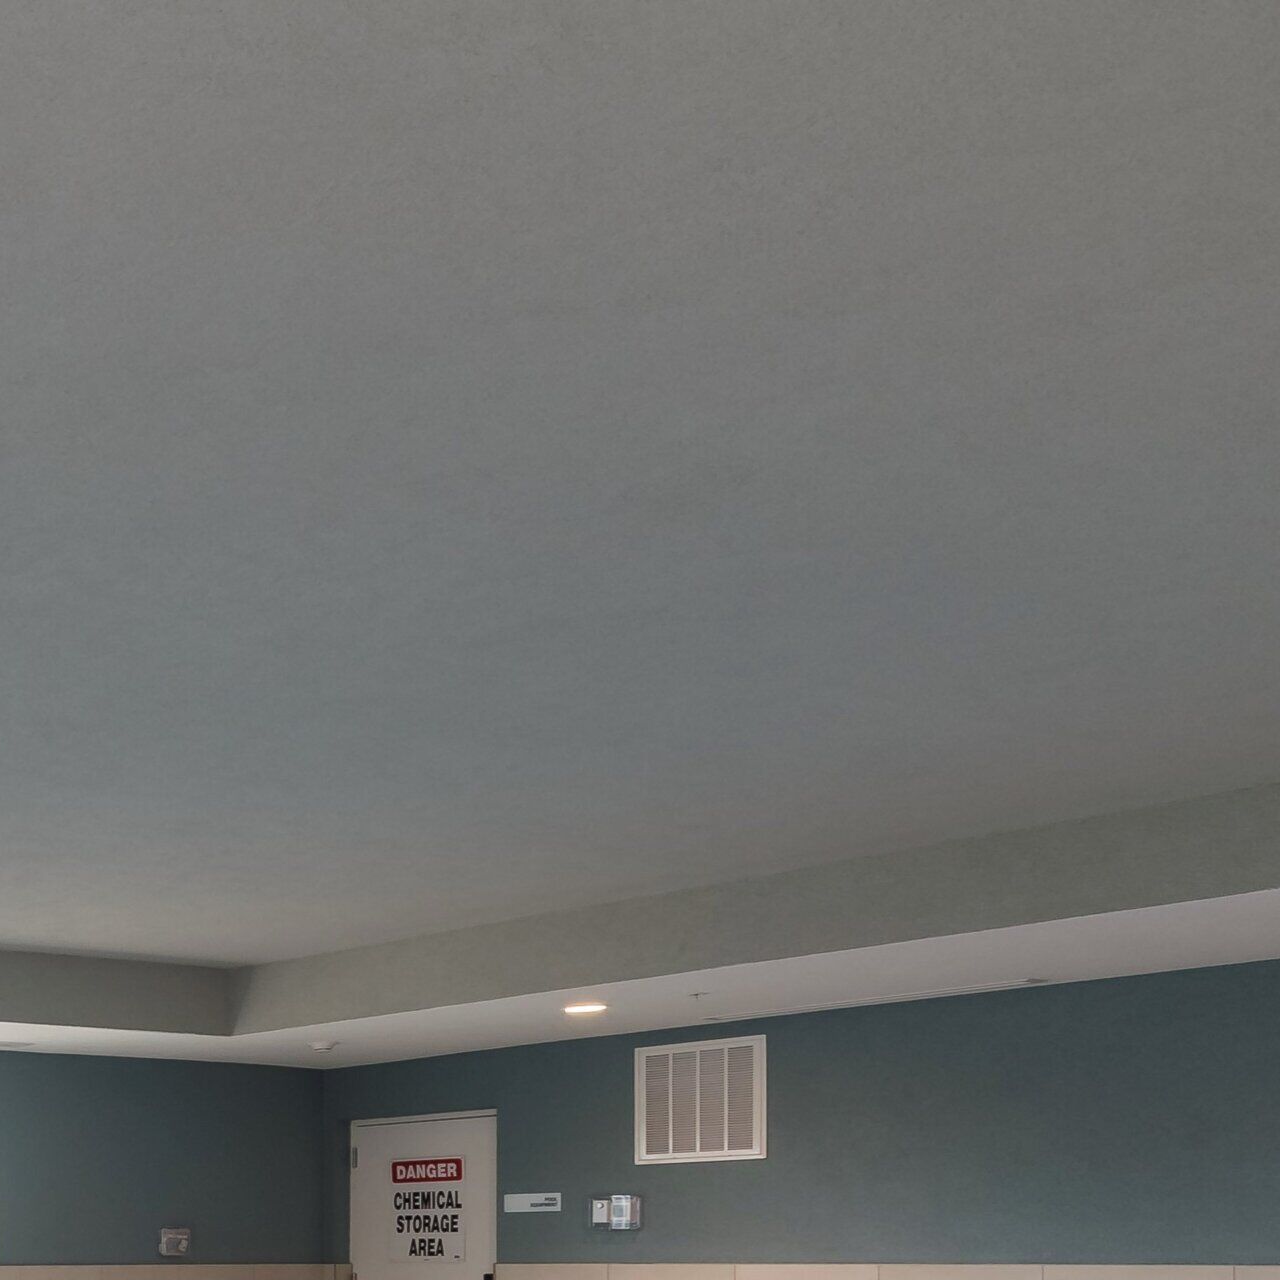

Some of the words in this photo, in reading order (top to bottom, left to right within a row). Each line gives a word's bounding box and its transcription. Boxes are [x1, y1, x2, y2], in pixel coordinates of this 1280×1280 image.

[396, 1163, 458, 1180] DANGER
[393, 1190, 462, 1210] CHEMICAL
[396, 1214, 459, 1233] STORAGE
[408, 1238, 445, 1257] AREA
